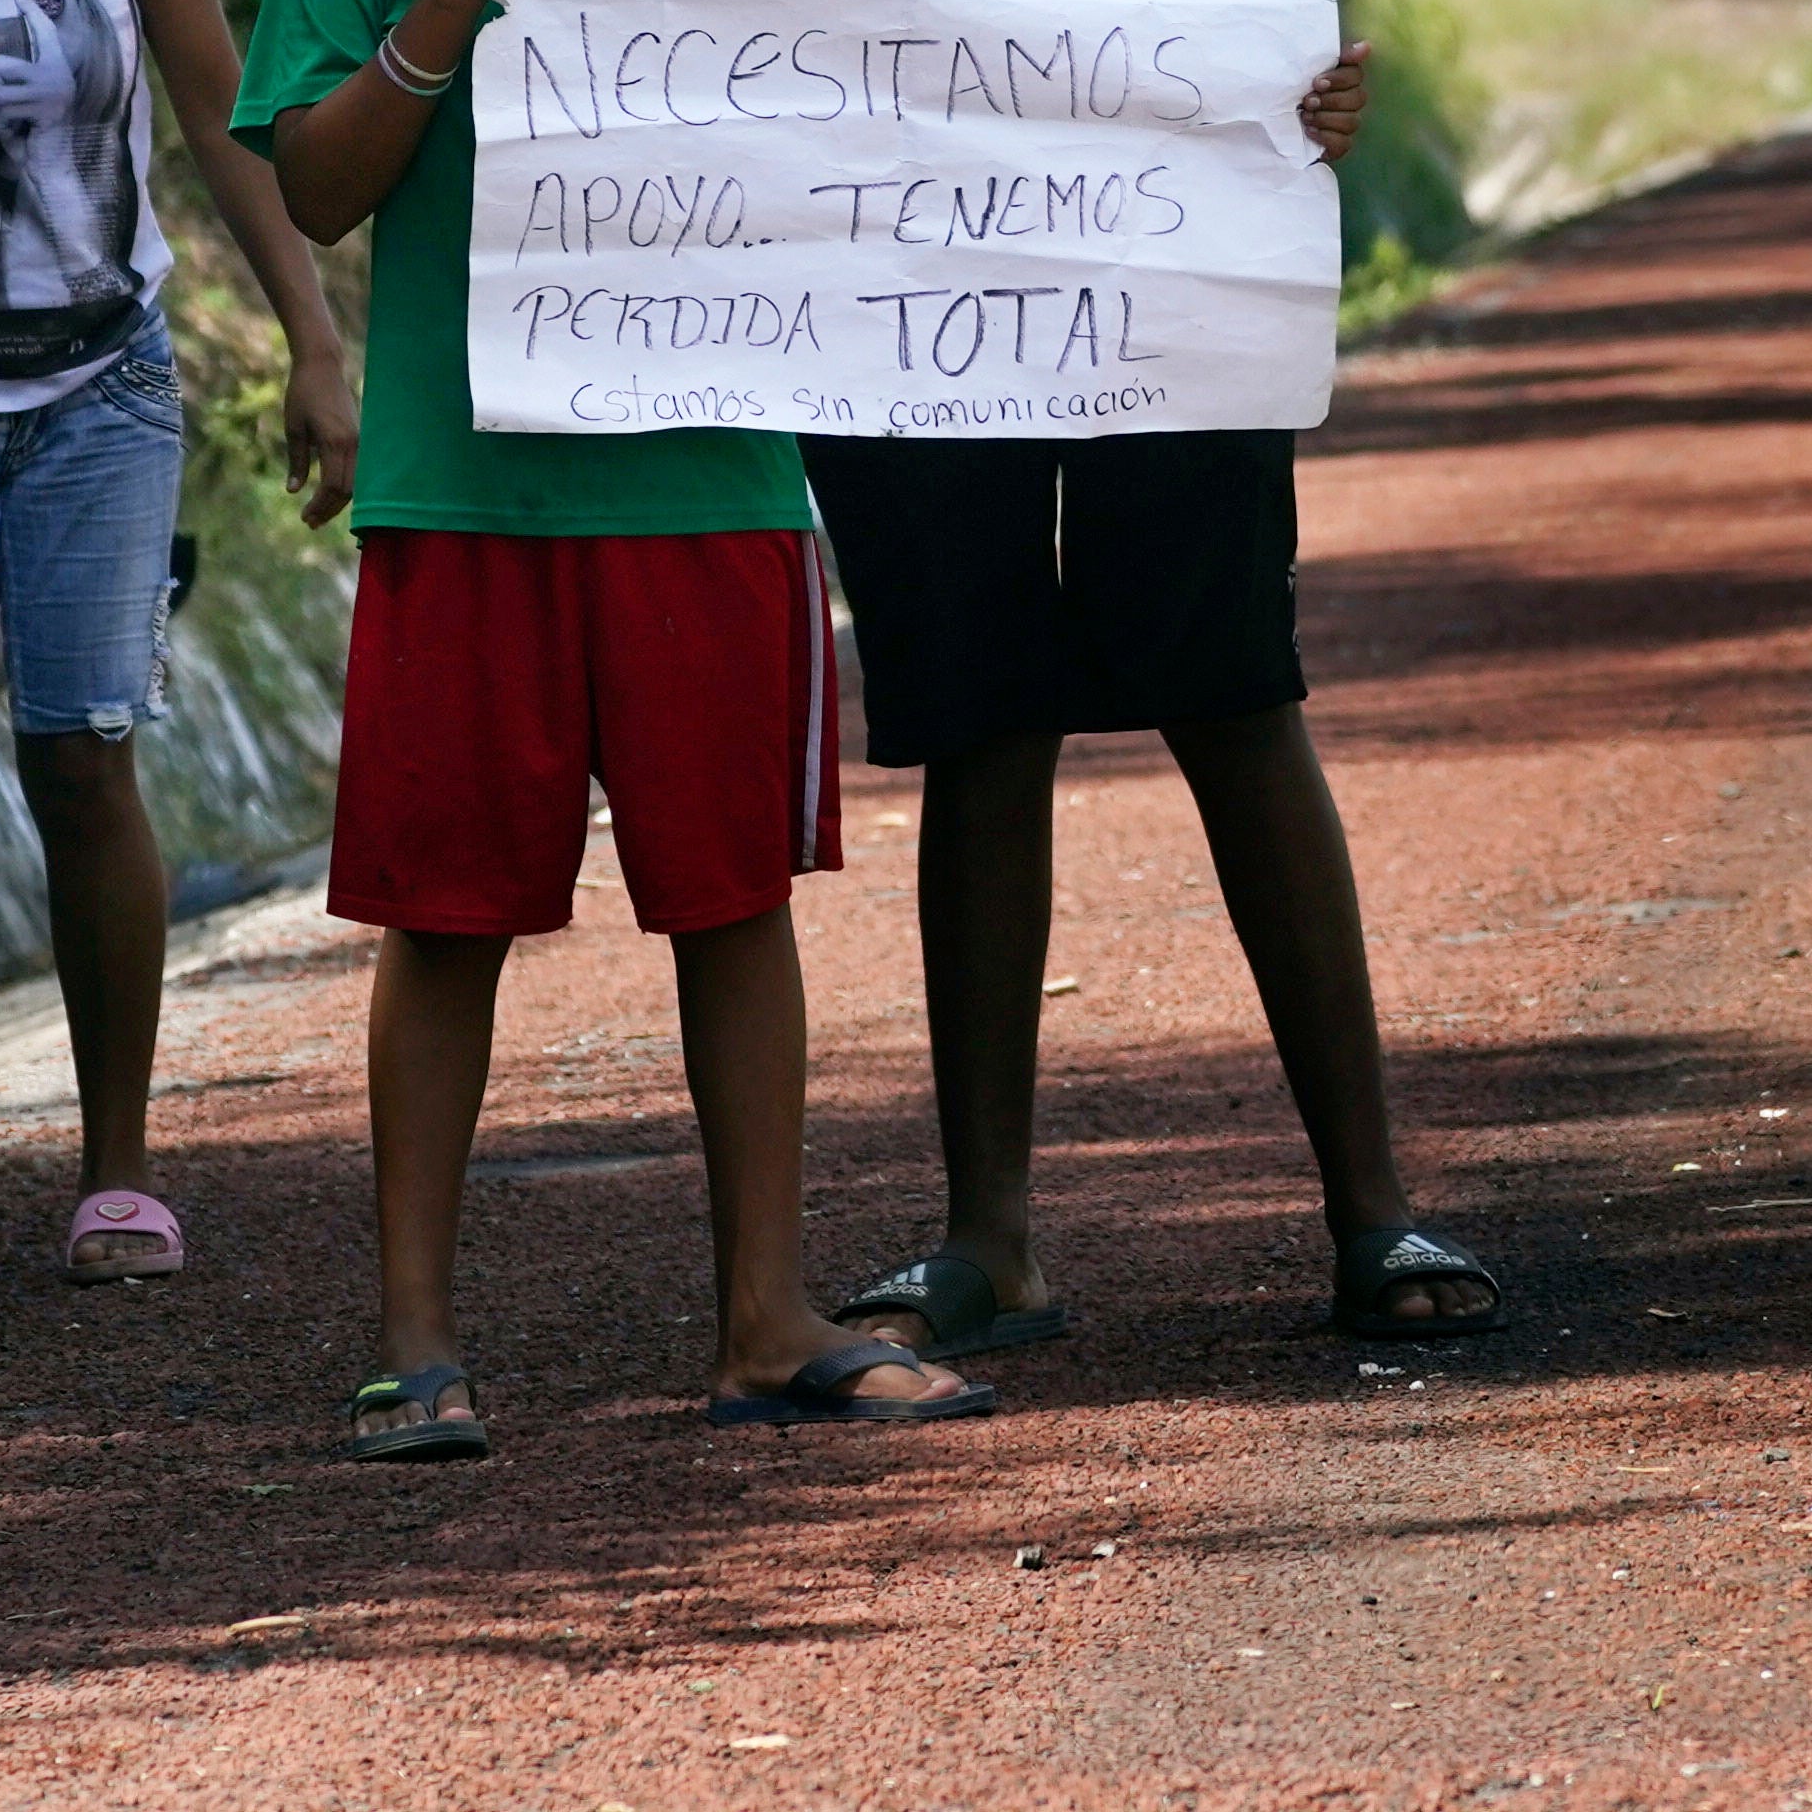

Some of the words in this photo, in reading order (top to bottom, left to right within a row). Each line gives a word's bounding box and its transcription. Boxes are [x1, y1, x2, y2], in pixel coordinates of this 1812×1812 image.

[523, 11, 1203, 140] NECESITAMOS
[808, 165, 1185, 247] TENEMOS
[512, 285, 821, 360] PERDIDA
[856, 287, 1164, 377] TOTAL
[570, 374, 765, 423] Estamos
[1383, 1252, 1466, 1269] adidas
